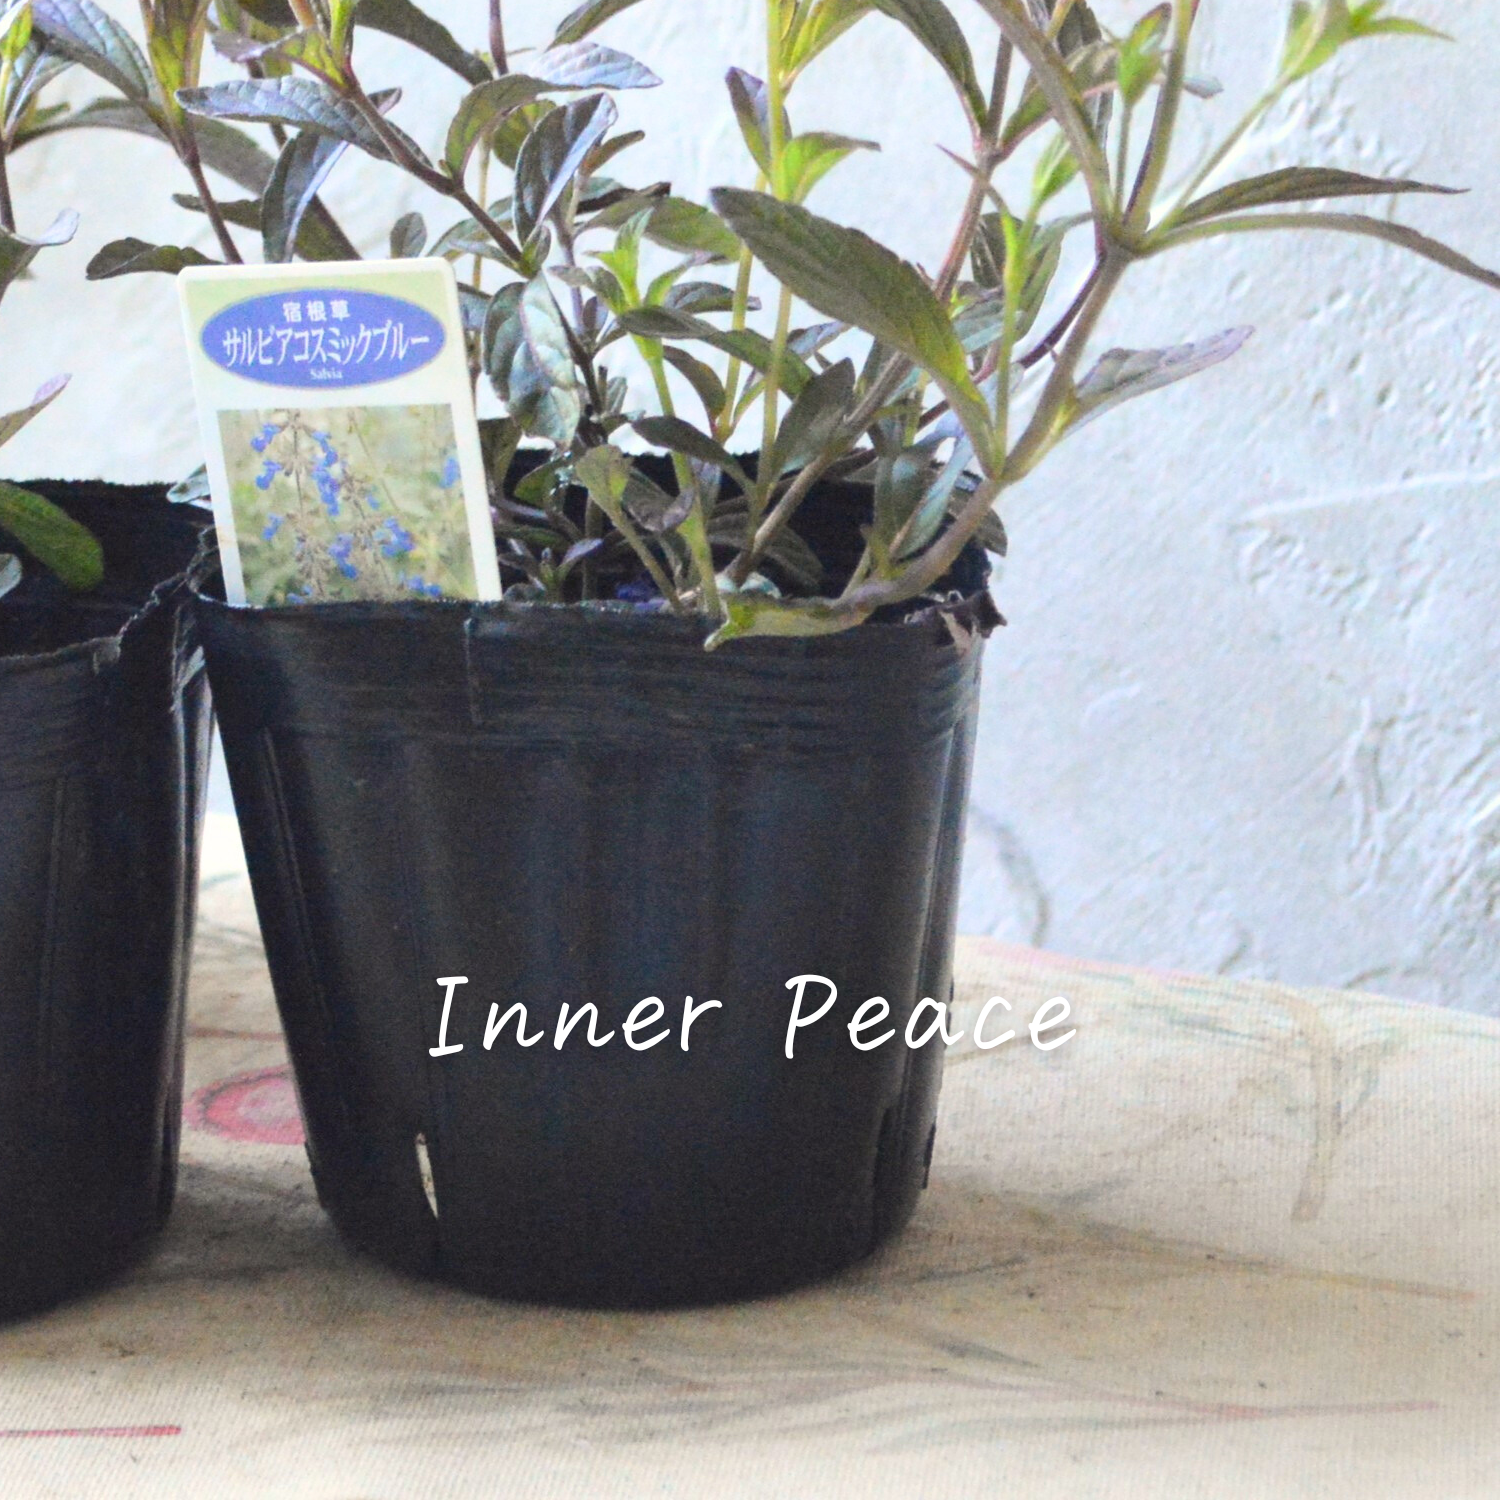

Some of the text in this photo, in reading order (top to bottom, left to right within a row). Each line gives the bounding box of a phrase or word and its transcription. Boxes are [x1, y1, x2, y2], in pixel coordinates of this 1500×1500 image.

[283, 300, 350, 322] 宿根草
[223, 320, 430, 367] サルビアコスミックブルー
[310, 368, 343, 380] Salvia
